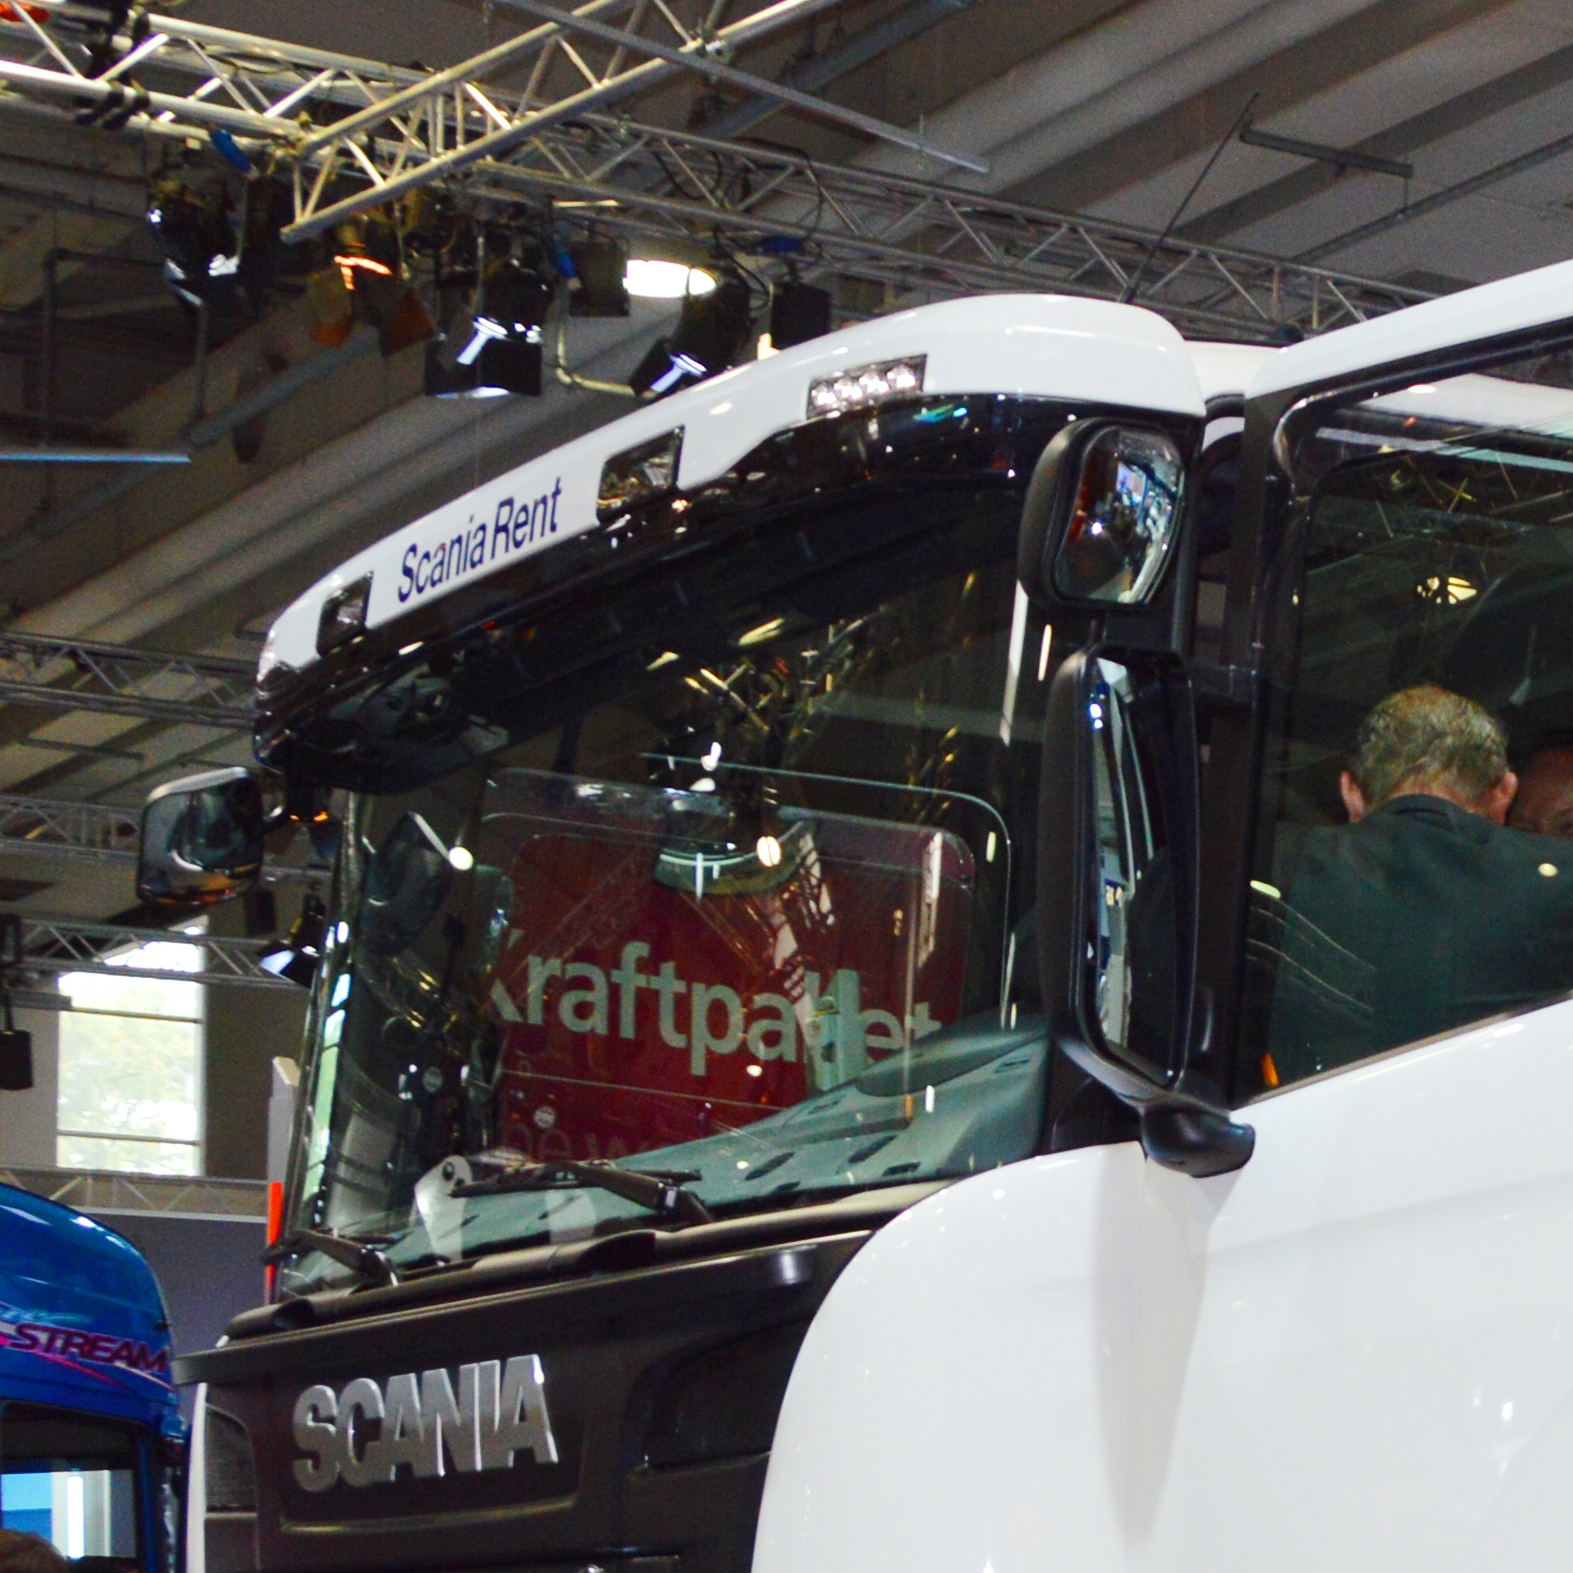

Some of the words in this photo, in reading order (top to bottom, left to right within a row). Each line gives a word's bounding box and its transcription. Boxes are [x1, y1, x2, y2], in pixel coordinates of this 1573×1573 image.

[398, 514, 487, 603] Scania
[491, 476, 562, 559] Rent
[9, 1322, 170, 1373] STREAM
[291, 1353, 559, 1492] SCANIA
